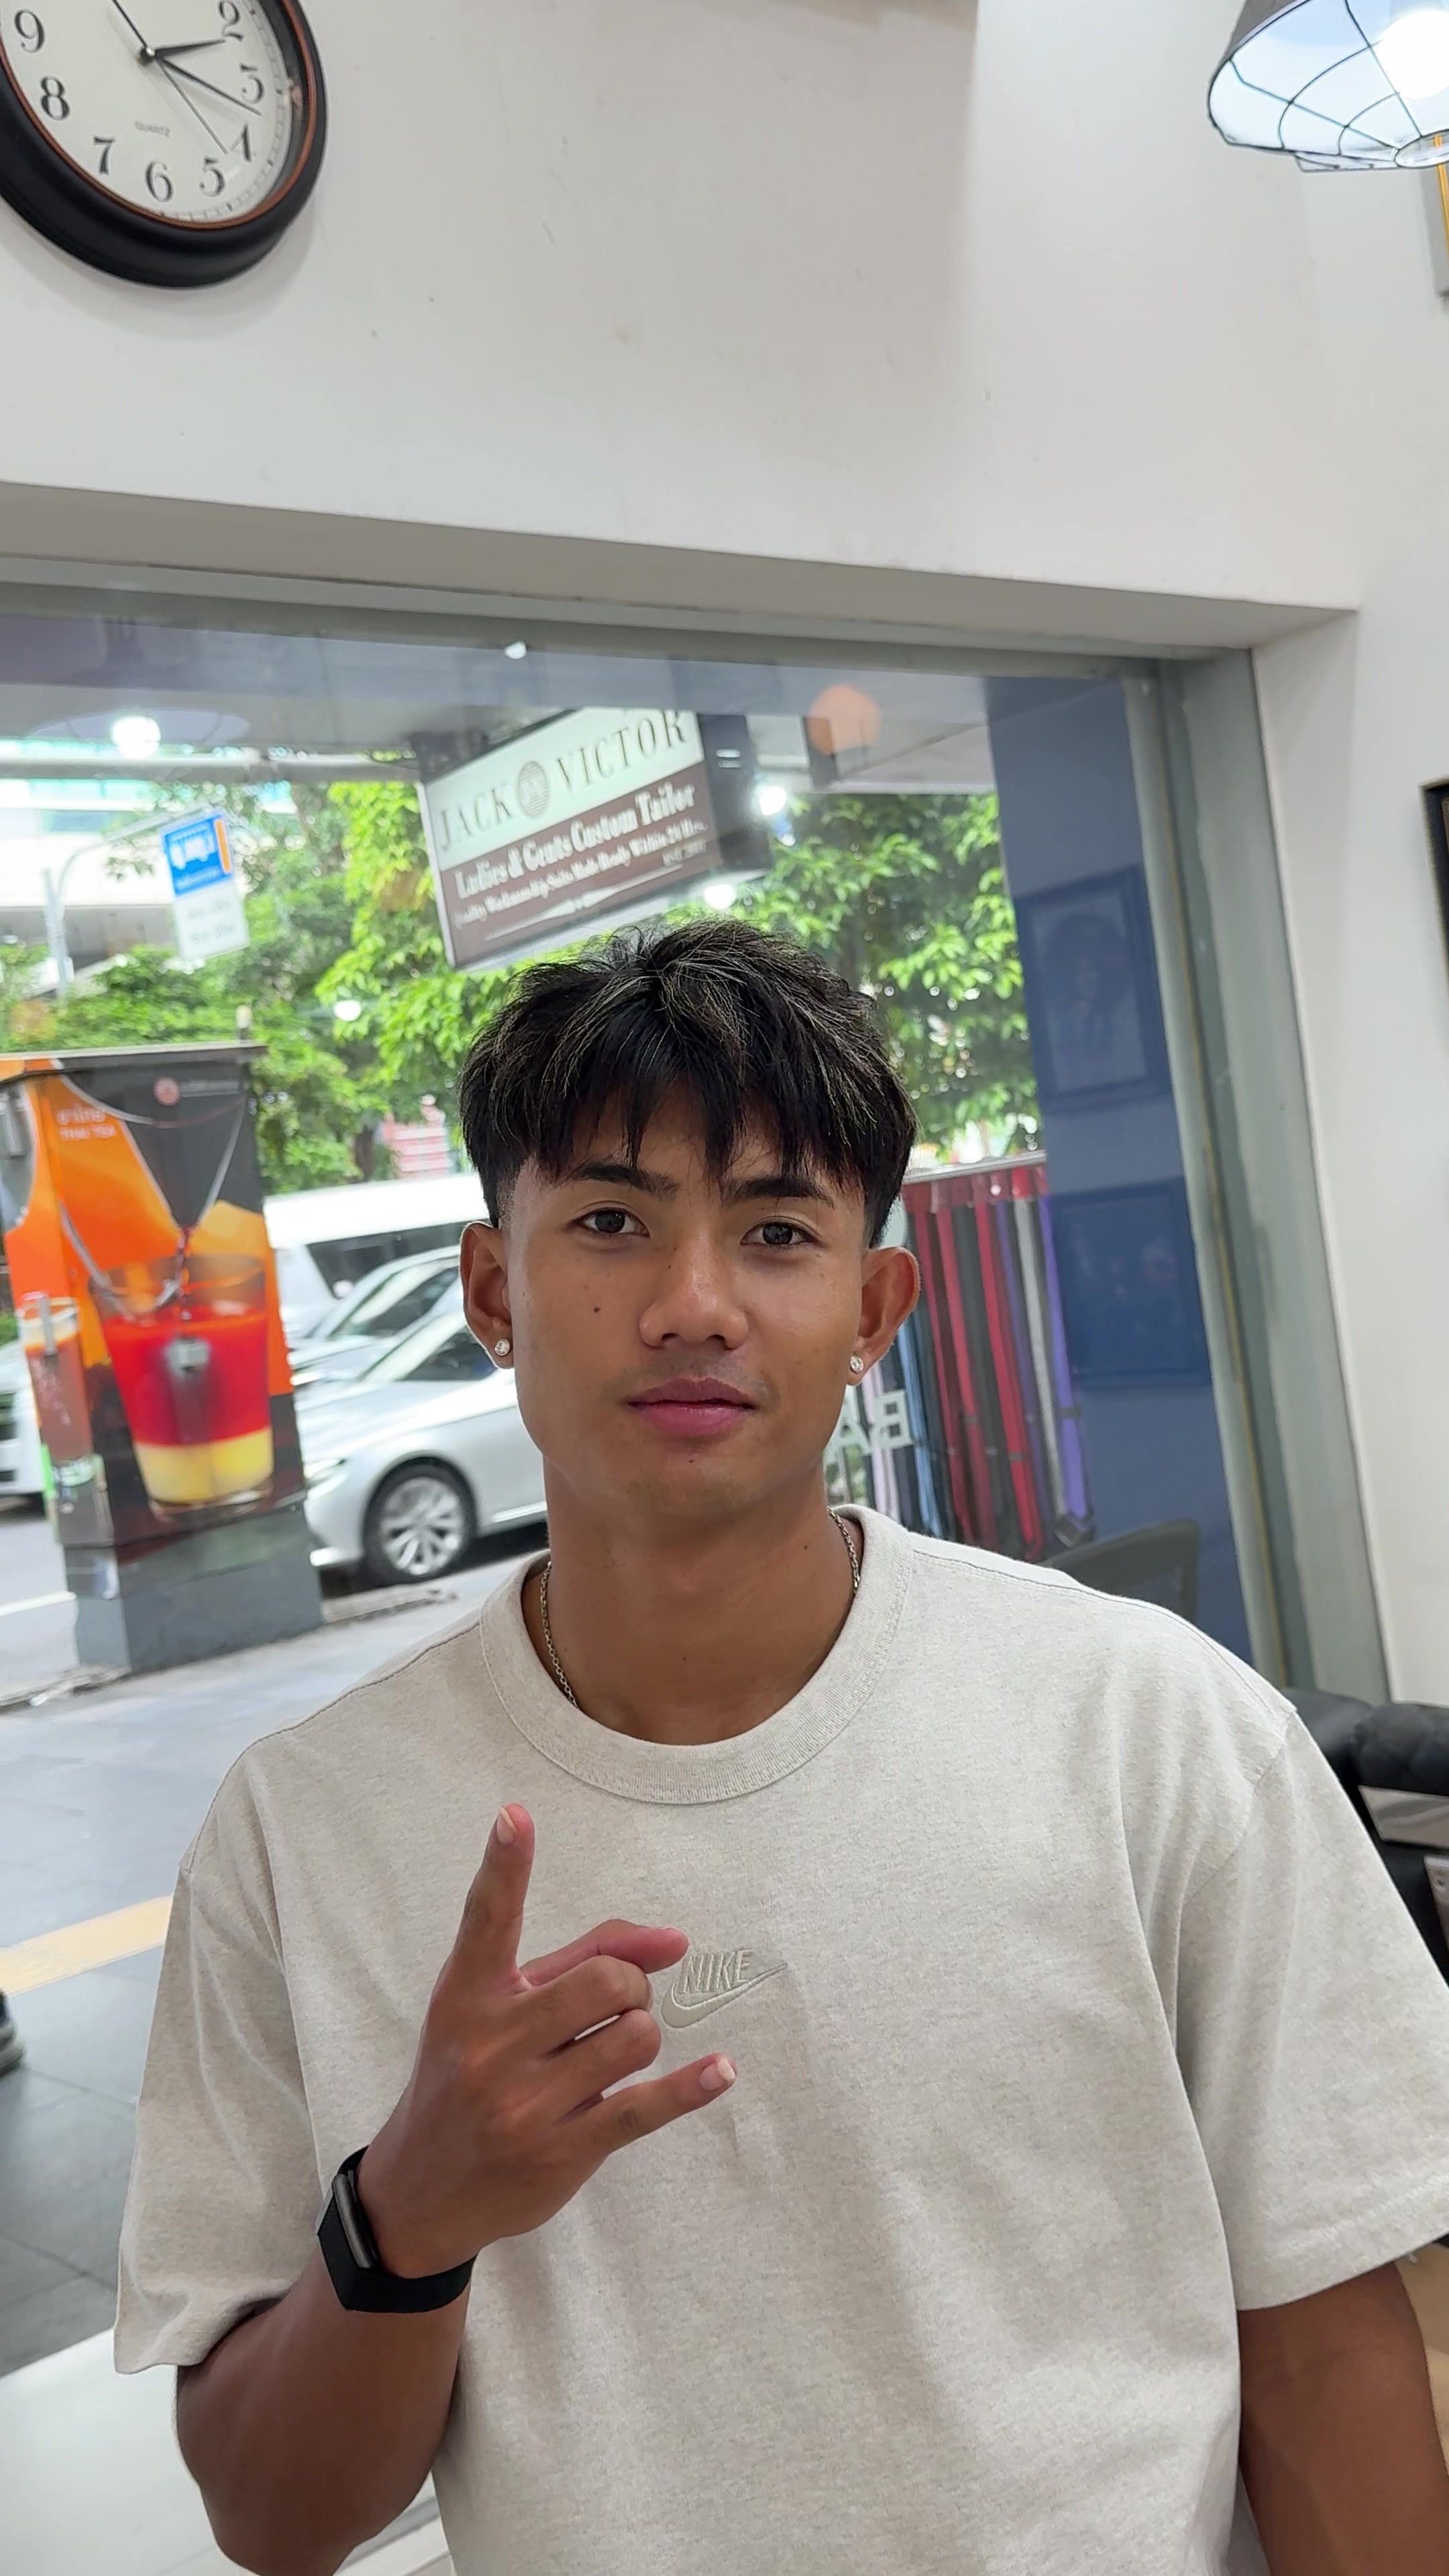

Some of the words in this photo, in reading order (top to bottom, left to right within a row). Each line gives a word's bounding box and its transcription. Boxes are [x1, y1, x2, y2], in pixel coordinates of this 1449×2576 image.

[14, 10, 45, 52] 9
[218, 0, 244, 42] 2
[40, 76, 70, 120] 8
[93, 136, 115, 175] 7
[229, 122, 255, 162] 4
[144, 160, 173, 203] 6
[199, 156, 225, 197] 5
[440, 782, 512, 853] JACK
[555, 710, 686, 790] VICTOR
[455, 859, 508, 900] Ladies
[523, 839, 573, 871] Gents
[571, 807, 639, 853] Custom
[635, 781, 696, 826] Tailor
[678, 1947, 753, 1994] NIKE
